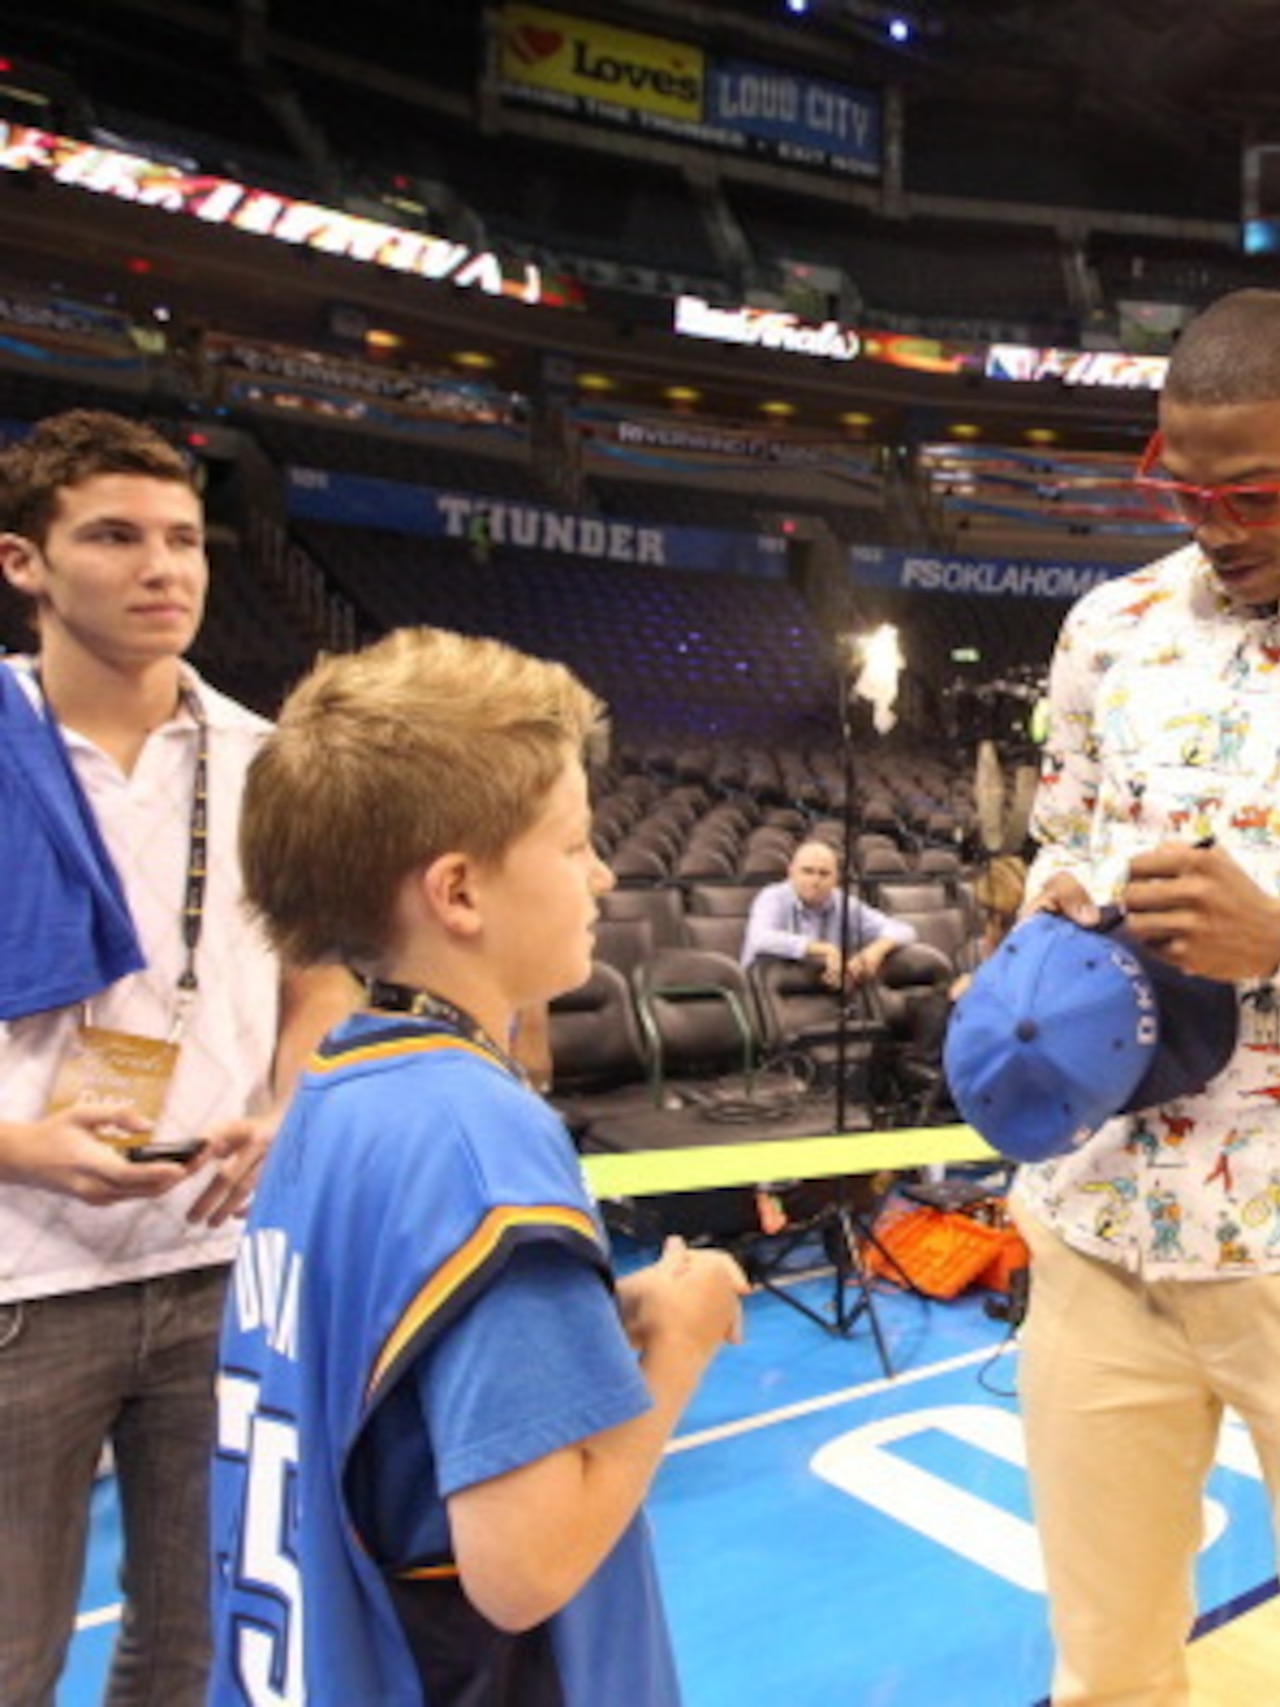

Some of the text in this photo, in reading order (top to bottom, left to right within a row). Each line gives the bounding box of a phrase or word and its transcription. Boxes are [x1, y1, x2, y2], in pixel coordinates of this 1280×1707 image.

[571, 39, 698, 103] Love's
[717, 72, 876, 148] LOUD CITY
[437, 496, 665, 565] THUNDER
